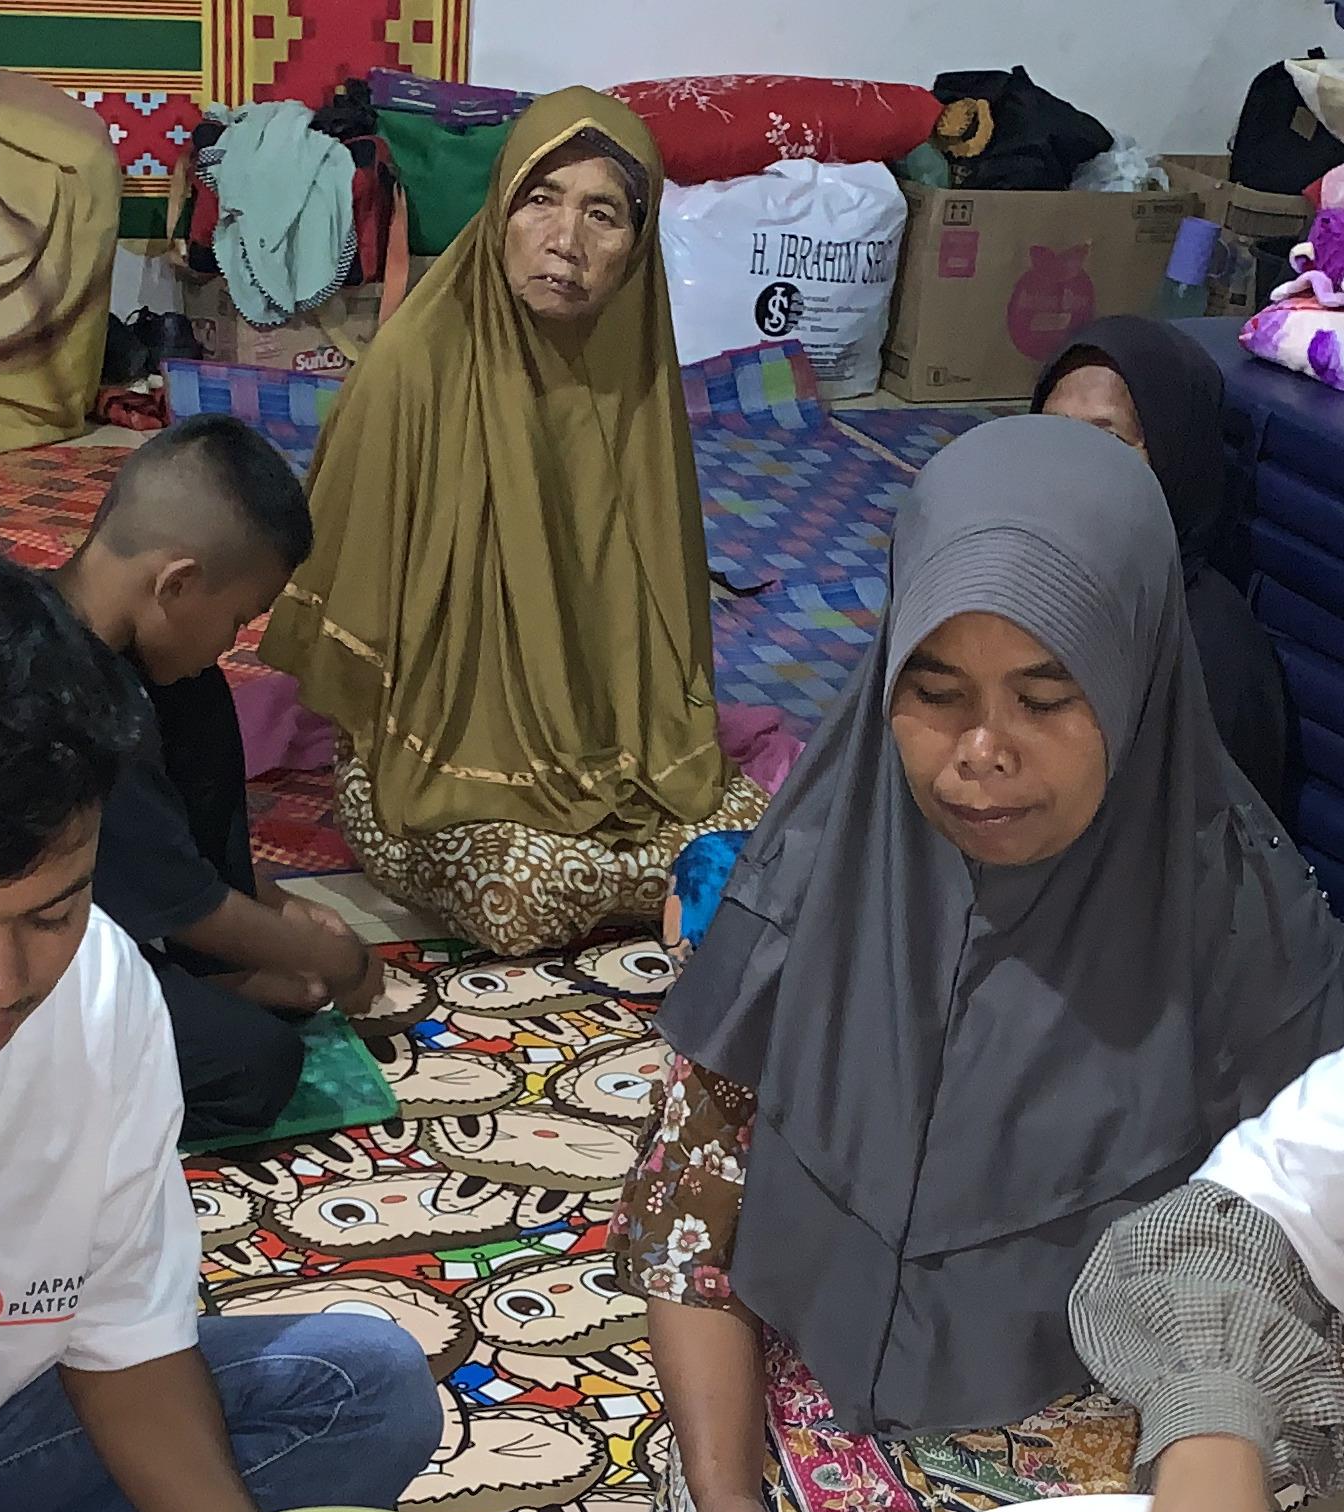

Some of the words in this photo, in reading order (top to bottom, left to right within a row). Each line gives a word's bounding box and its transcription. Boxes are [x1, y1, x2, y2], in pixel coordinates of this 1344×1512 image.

[749, 232, 770, 276] H.
[776, 233, 857, 284] IBRAHIM
[294, 347, 345, 372] SunCo
[8, 1294, 79, 1316] PLATFO
